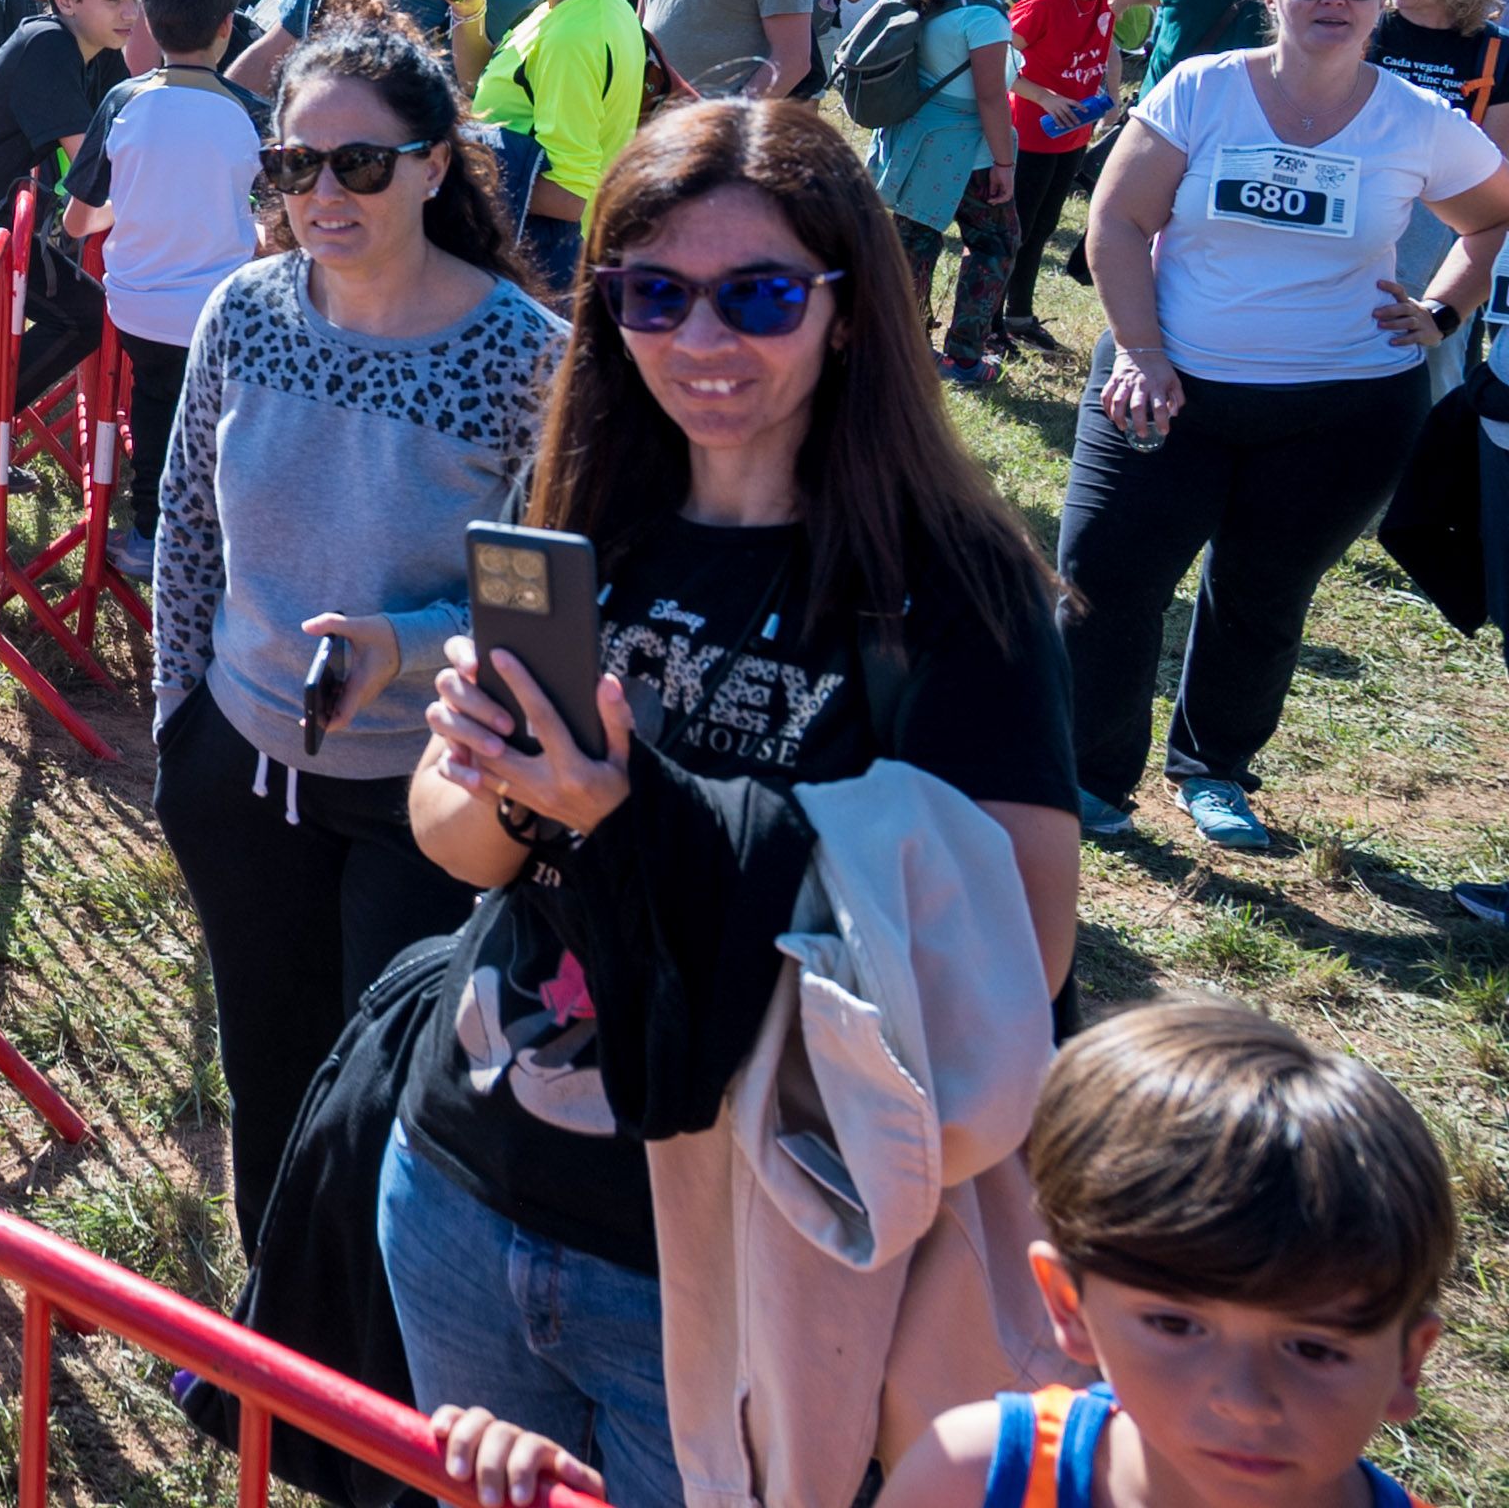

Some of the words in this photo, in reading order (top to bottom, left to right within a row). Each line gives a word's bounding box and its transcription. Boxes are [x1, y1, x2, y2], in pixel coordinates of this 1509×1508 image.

[1382, 56, 1412, 68] Cada
[1413, 62, 1455, 75] vegada
[1240, 182, 1306, 216] 680
[648, 599, 706, 634] Disney
[684, 722, 800, 767] MOUSE
